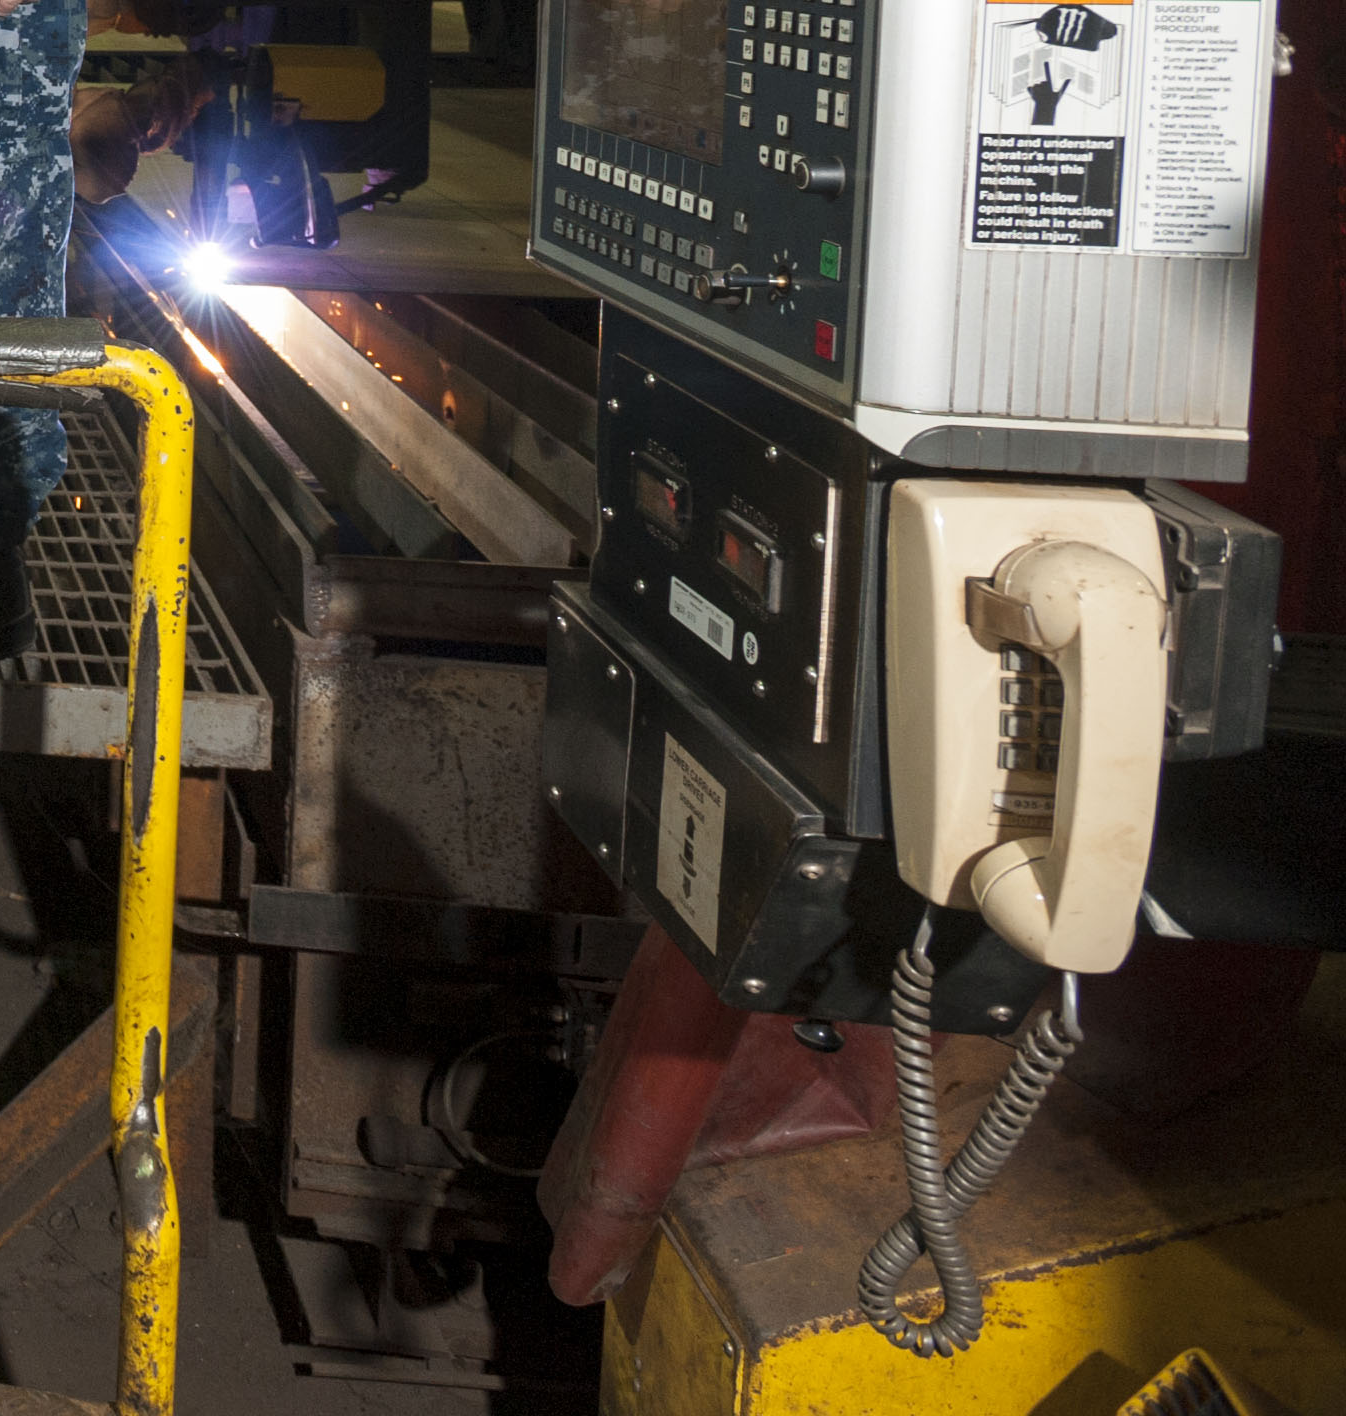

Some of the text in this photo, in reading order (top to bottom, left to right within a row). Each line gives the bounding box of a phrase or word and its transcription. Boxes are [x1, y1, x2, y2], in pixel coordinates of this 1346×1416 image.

[1155, 5, 1220, 14] SUGGESTED
[1154, 15, 1206, 23] LOCKOUT
[1154, 25, 1220, 33] PROCEDURE
[982, 136, 1115, 150] Read and understand
[981, 150, 1094, 162] operator's manual
[980, 162, 1085, 176] before using this
[980, 176, 1037, 186] machine.
[979, 190, 1079, 203] Failure to follow
[978, 204, 1115, 217] operating instructions
[977, 216, 1104, 229] could result in death
[976, 230, 1081, 243] or serious injury.
